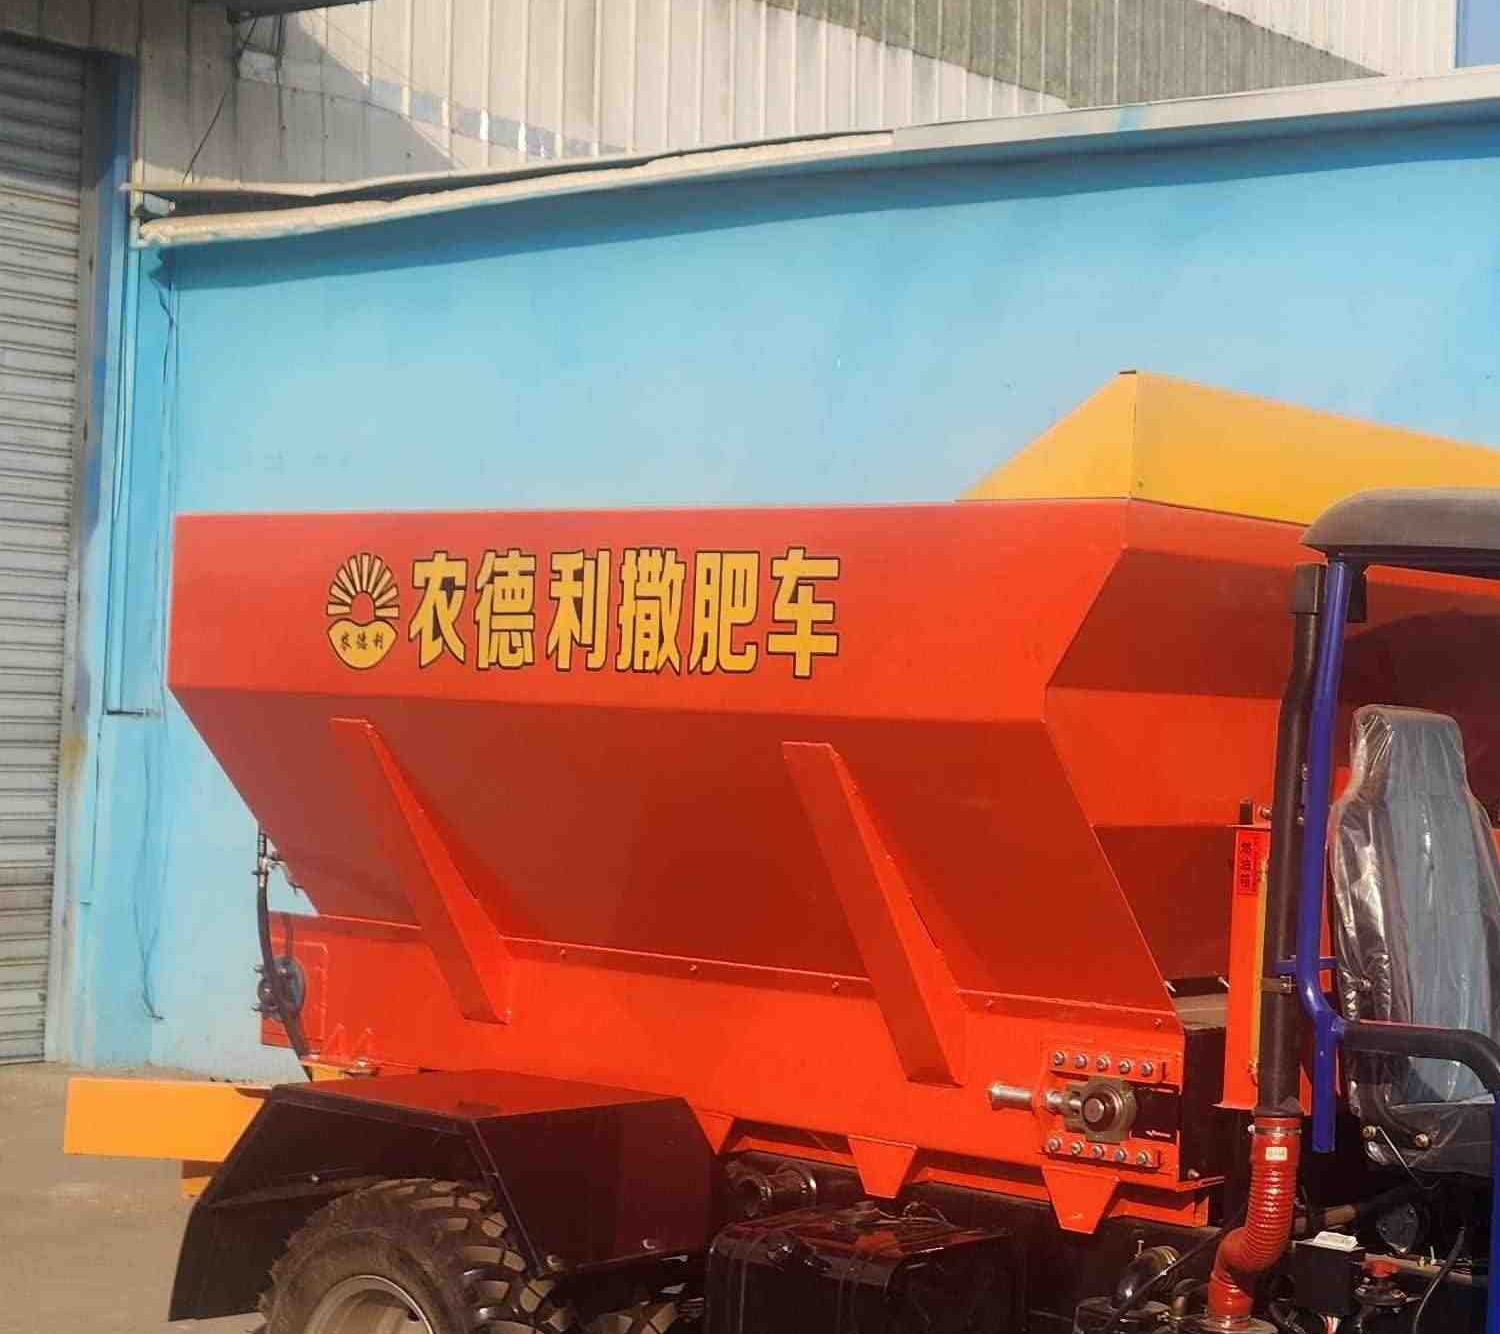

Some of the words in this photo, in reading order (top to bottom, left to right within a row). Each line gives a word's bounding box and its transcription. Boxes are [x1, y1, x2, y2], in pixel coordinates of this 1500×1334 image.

[408, 547, 840, 679] 农德利撒肥车
